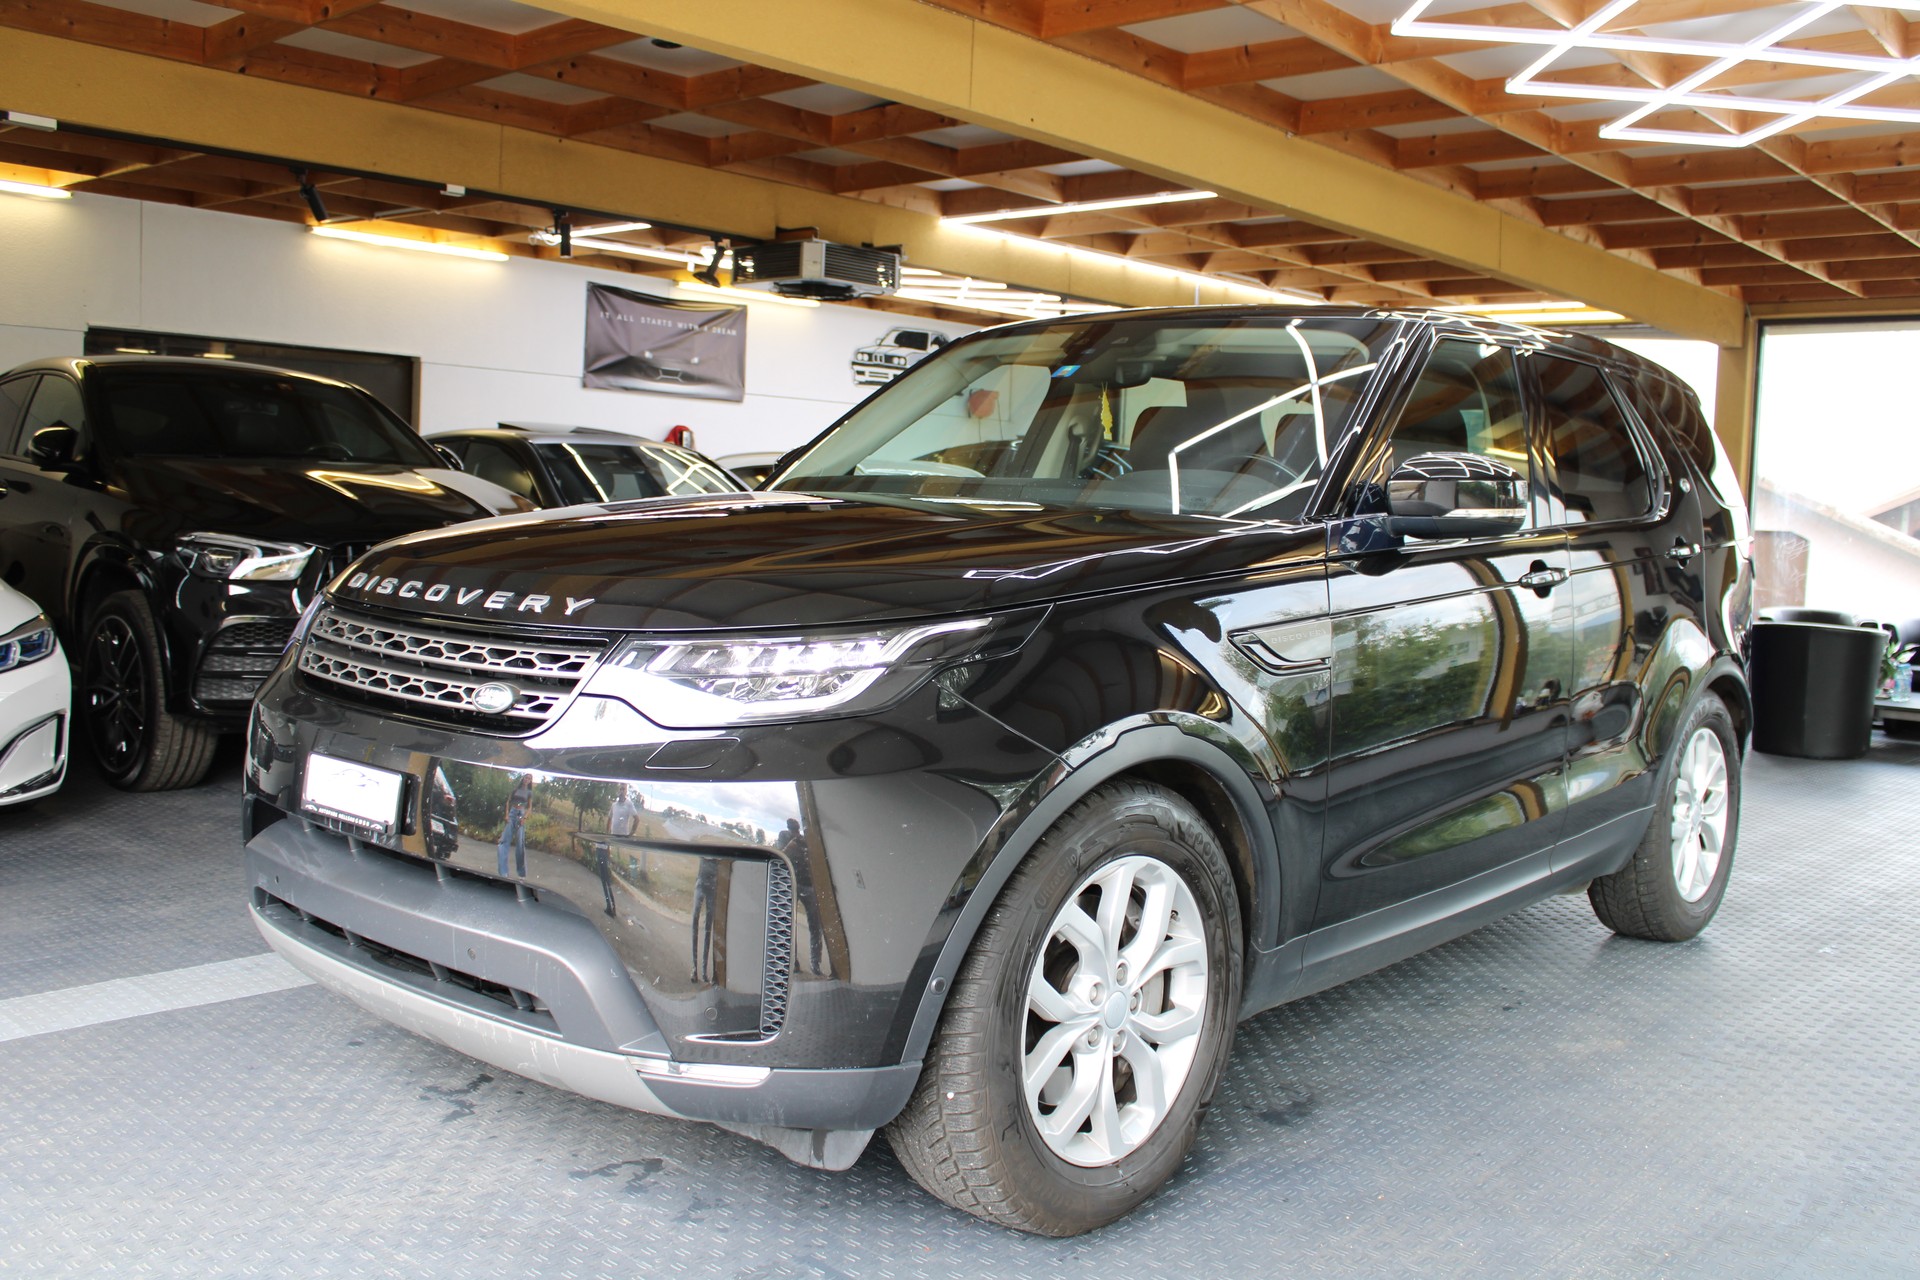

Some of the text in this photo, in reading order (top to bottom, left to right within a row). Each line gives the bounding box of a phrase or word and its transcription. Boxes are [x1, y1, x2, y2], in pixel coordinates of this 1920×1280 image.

[599, 311, 610, 320] IT
[616, 313, 634, 322] ALL
[640, 316, 673, 328] STARTS
[677, 322, 699, 332] WITH
[711, 326, 737, 336] DREAM
[347, 572, 596, 616] DISCOVERY
